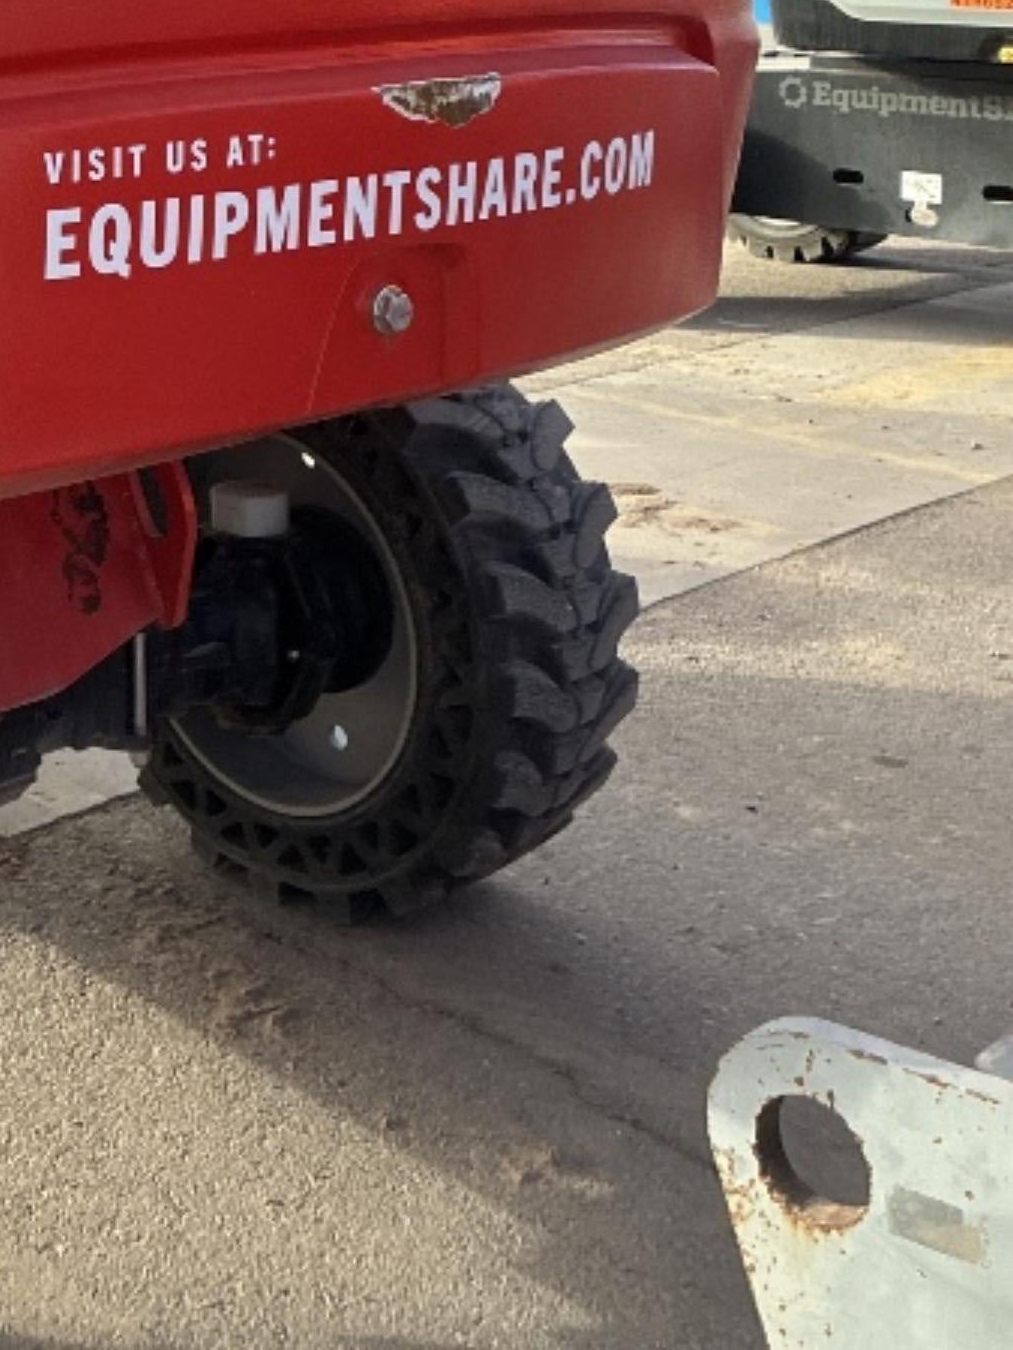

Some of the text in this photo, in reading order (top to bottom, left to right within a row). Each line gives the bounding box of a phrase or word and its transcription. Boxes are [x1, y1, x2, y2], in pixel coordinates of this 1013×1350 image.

[43, 133, 277, 184] VISIT US AT:
[43, 131, 655, 281] EQUIPMENTSHARE.COM
